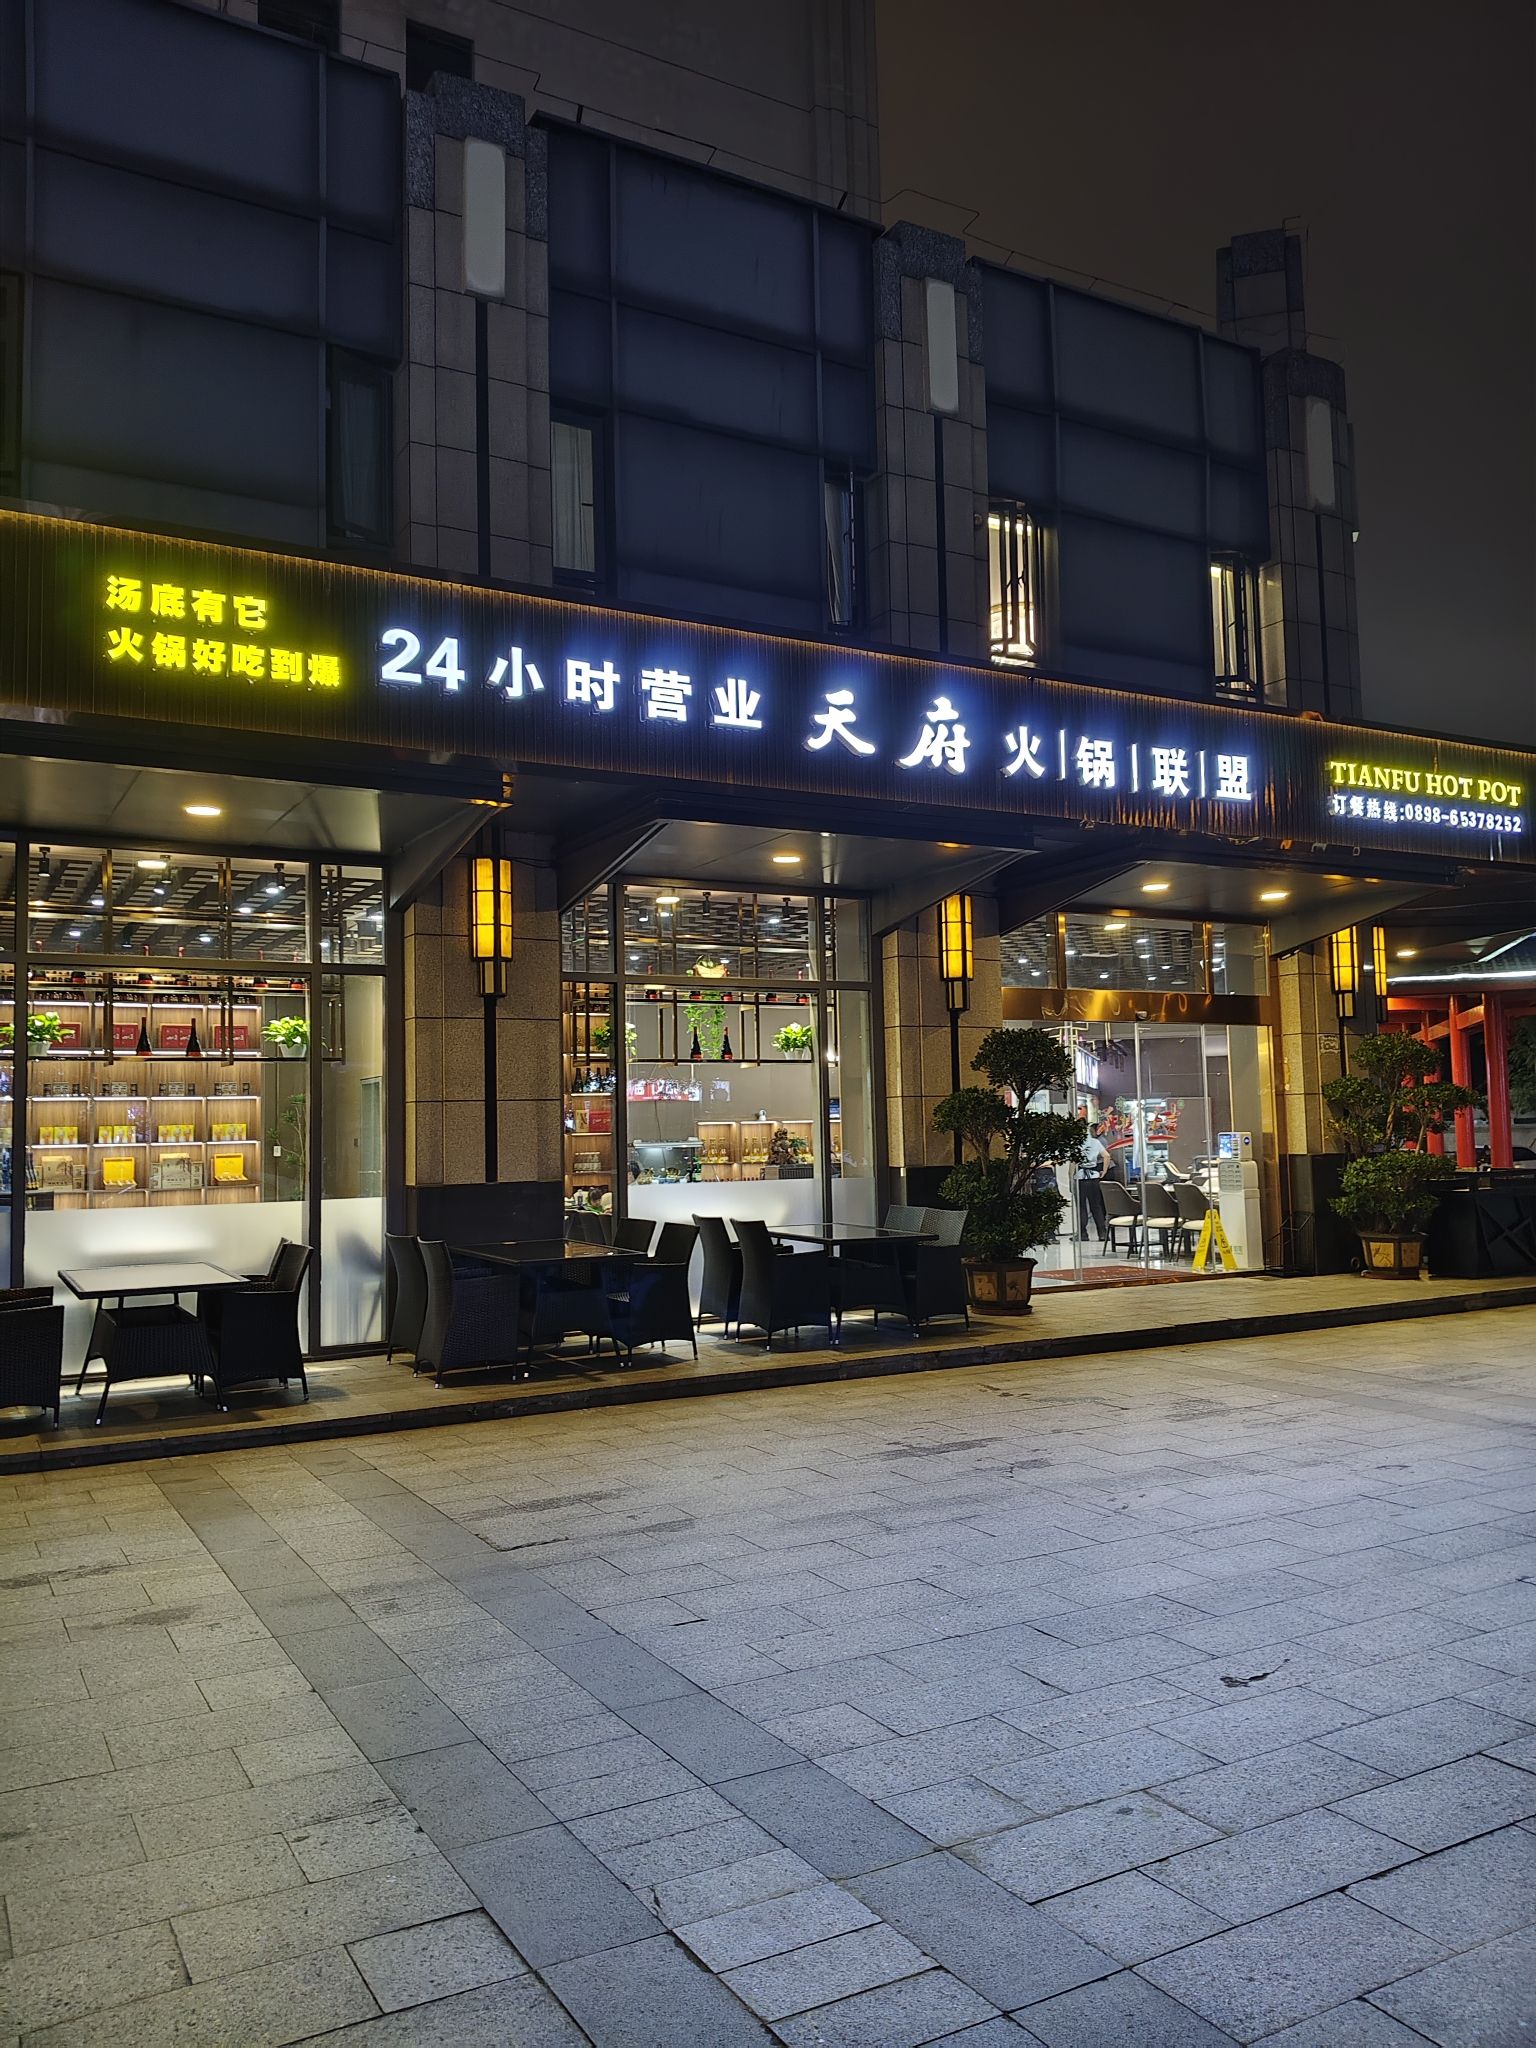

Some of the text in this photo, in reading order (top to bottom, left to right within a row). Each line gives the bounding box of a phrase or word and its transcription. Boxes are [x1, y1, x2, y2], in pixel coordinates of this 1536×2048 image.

[106, 575, 266, 629] 汤底有它
[107, 627, 341, 687] 火锅好吃到爆
[1330, 761, 1521, 807] TIANFU HOT POT
